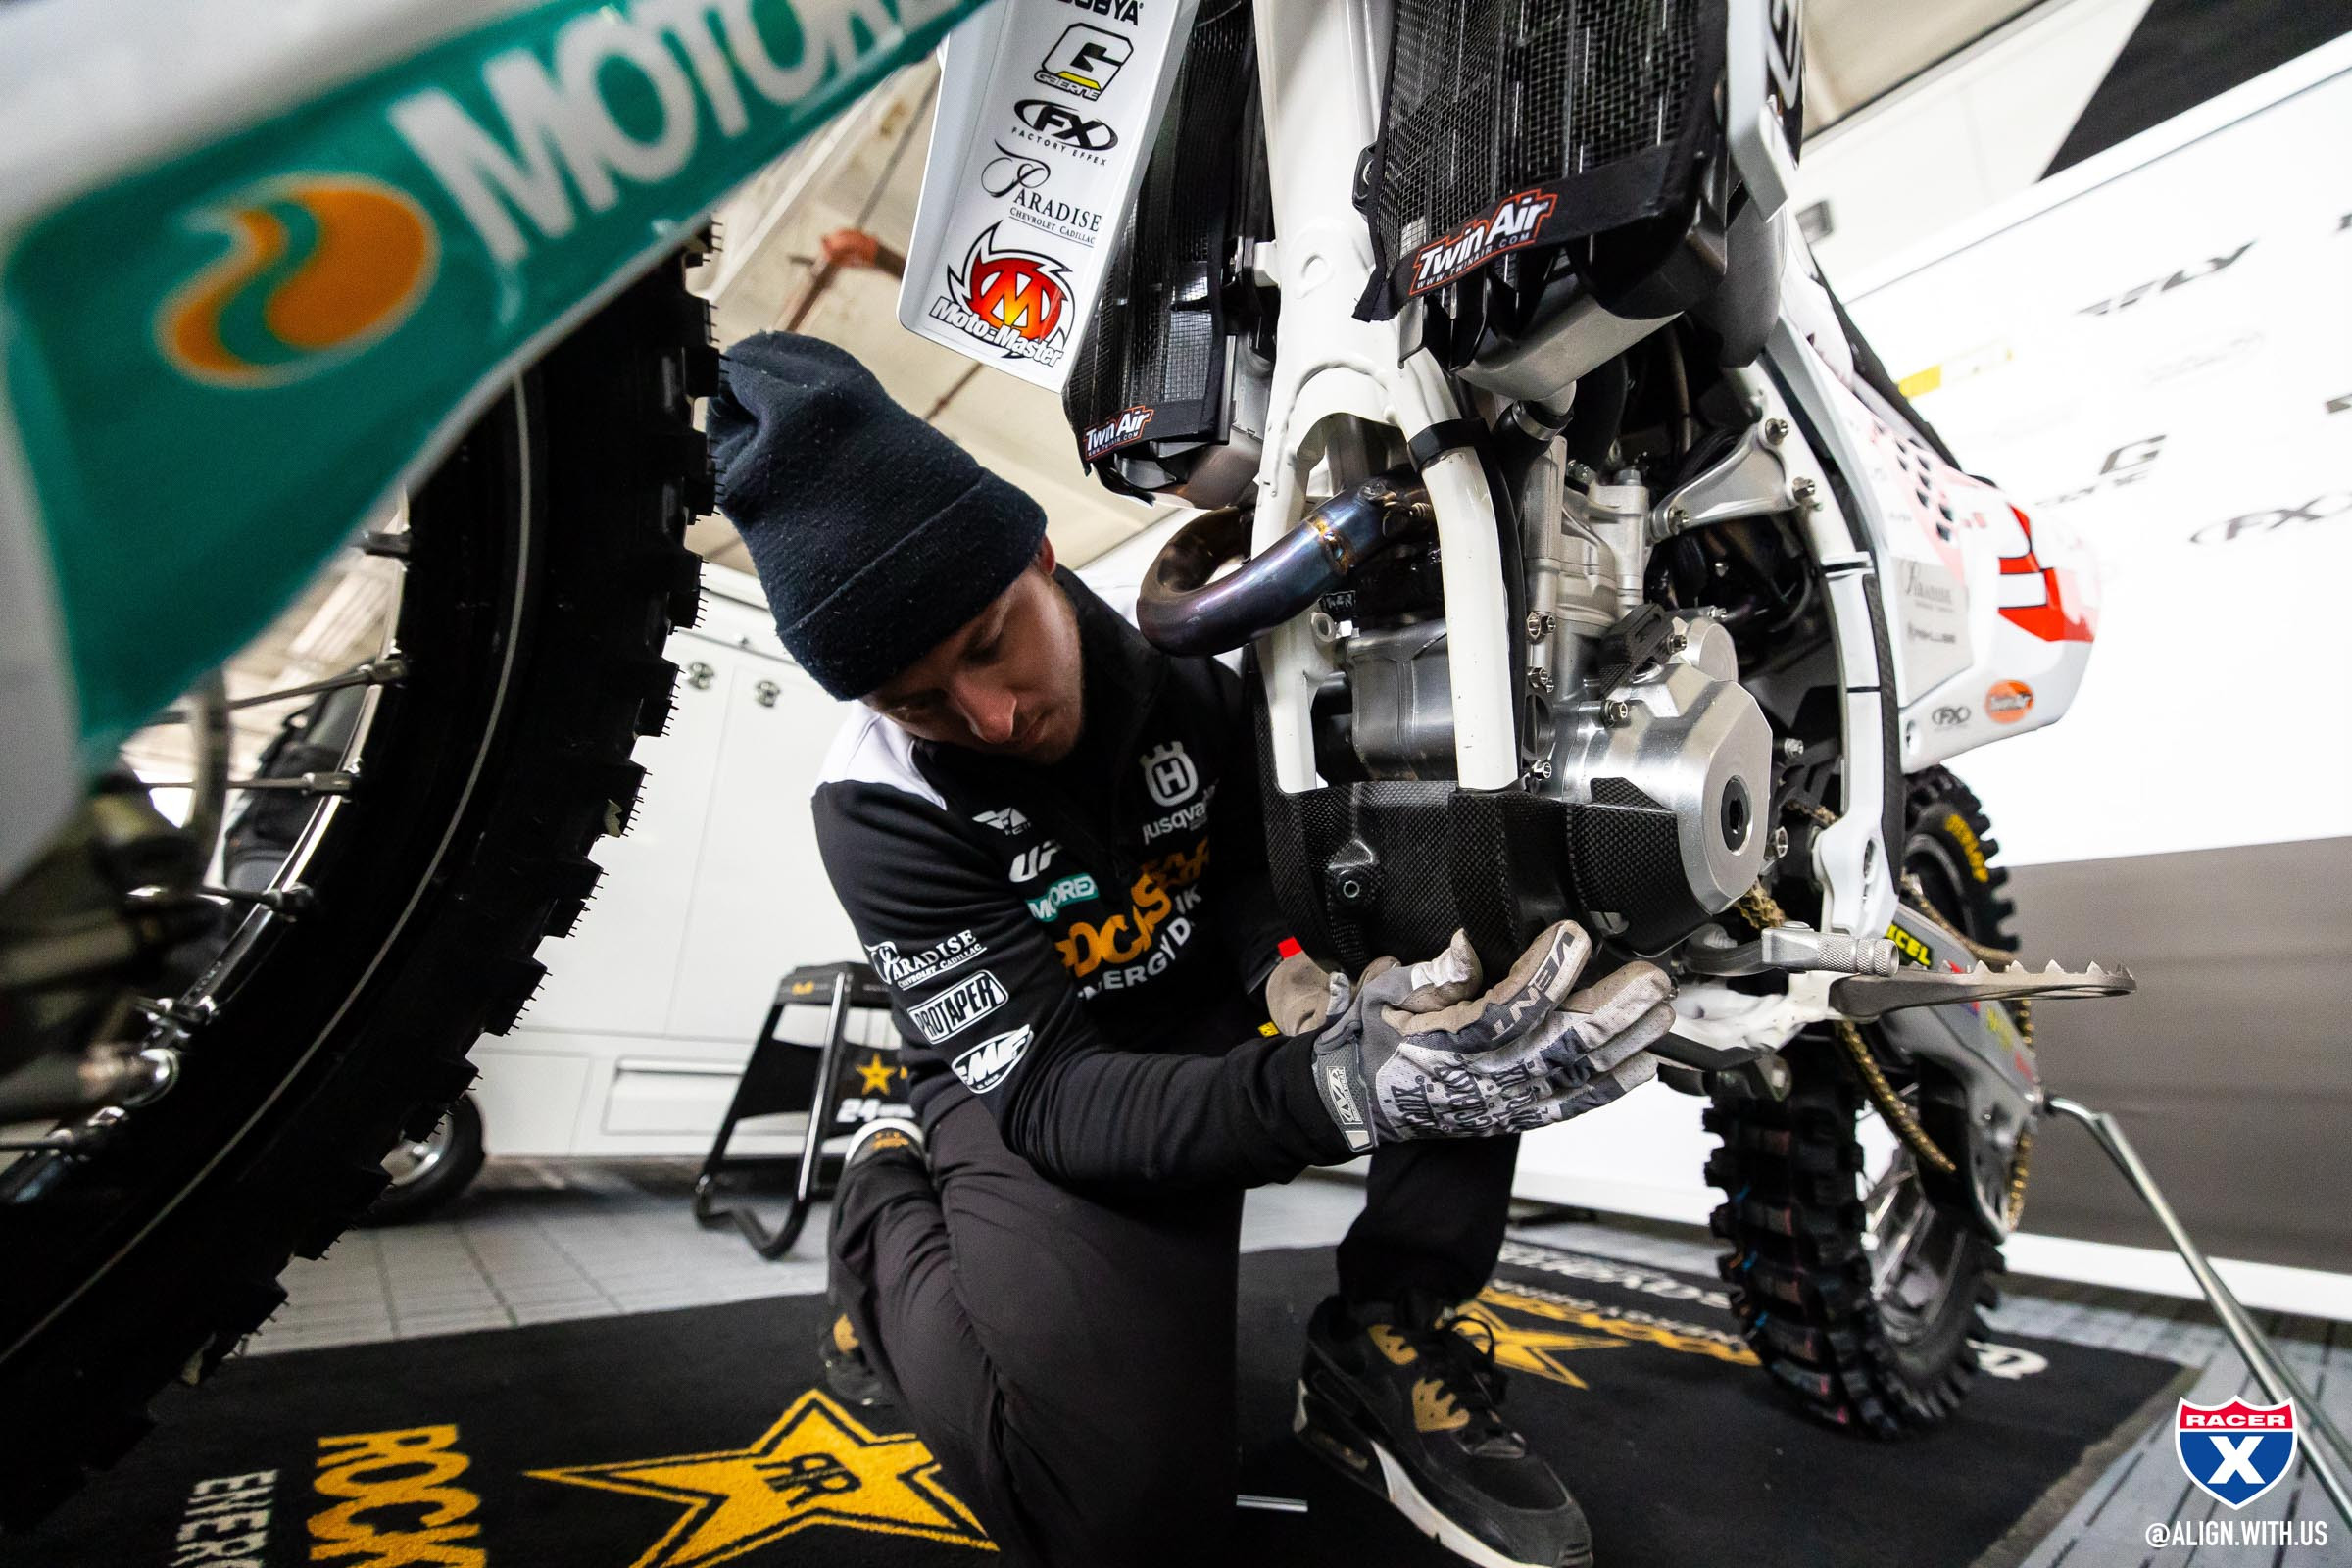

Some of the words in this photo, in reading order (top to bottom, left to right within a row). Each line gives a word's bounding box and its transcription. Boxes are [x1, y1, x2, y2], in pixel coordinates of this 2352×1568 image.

[1011, 126, 1066, 153] FACTORY
[1072, 149, 1107, 166] EFFEX
[1033, 105, 1104, 148] FX
[981, 138, 1102, 233] PARADISE
[1009, 207, 1056, 231] CHEVROLET
[1059, 225, 1097, 245] CADILLAC
[1419, 226, 1486, 280] Twin
[1485, 197, 1550, 245] Air
[1086, 421, 1116, 451] Twin
[1116, 410, 1151, 437] Air
[864, 930, 977, 985] PARADISE
[939, 943, 982, 970] CADILLAC
[915, 975, 998, 1037] PROTAPER
[1491, 931, 1576, 1041] VENT
